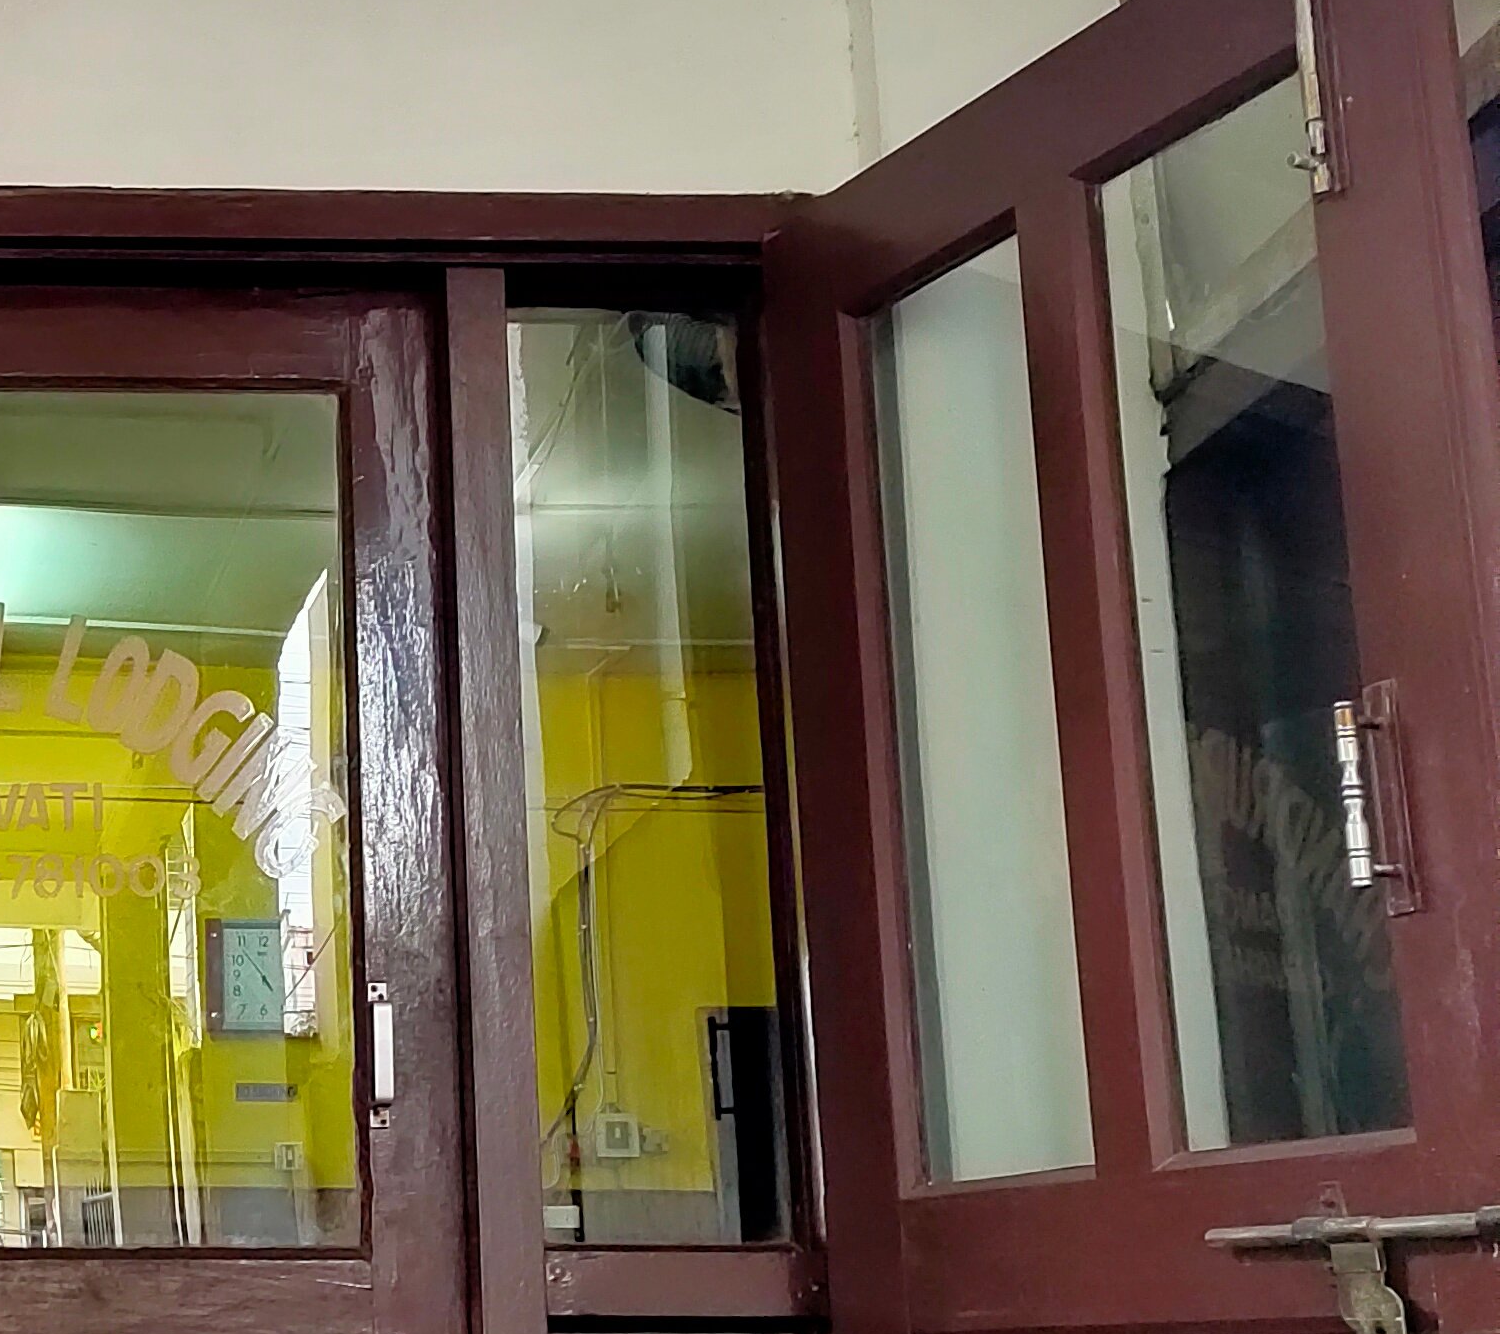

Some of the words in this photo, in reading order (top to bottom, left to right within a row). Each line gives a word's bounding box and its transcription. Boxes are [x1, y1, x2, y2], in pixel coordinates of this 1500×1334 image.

[45, 614, 347, 880] LODGING
[258, 935, 269, 947] 12
[231, 954, 244, 967] 10
